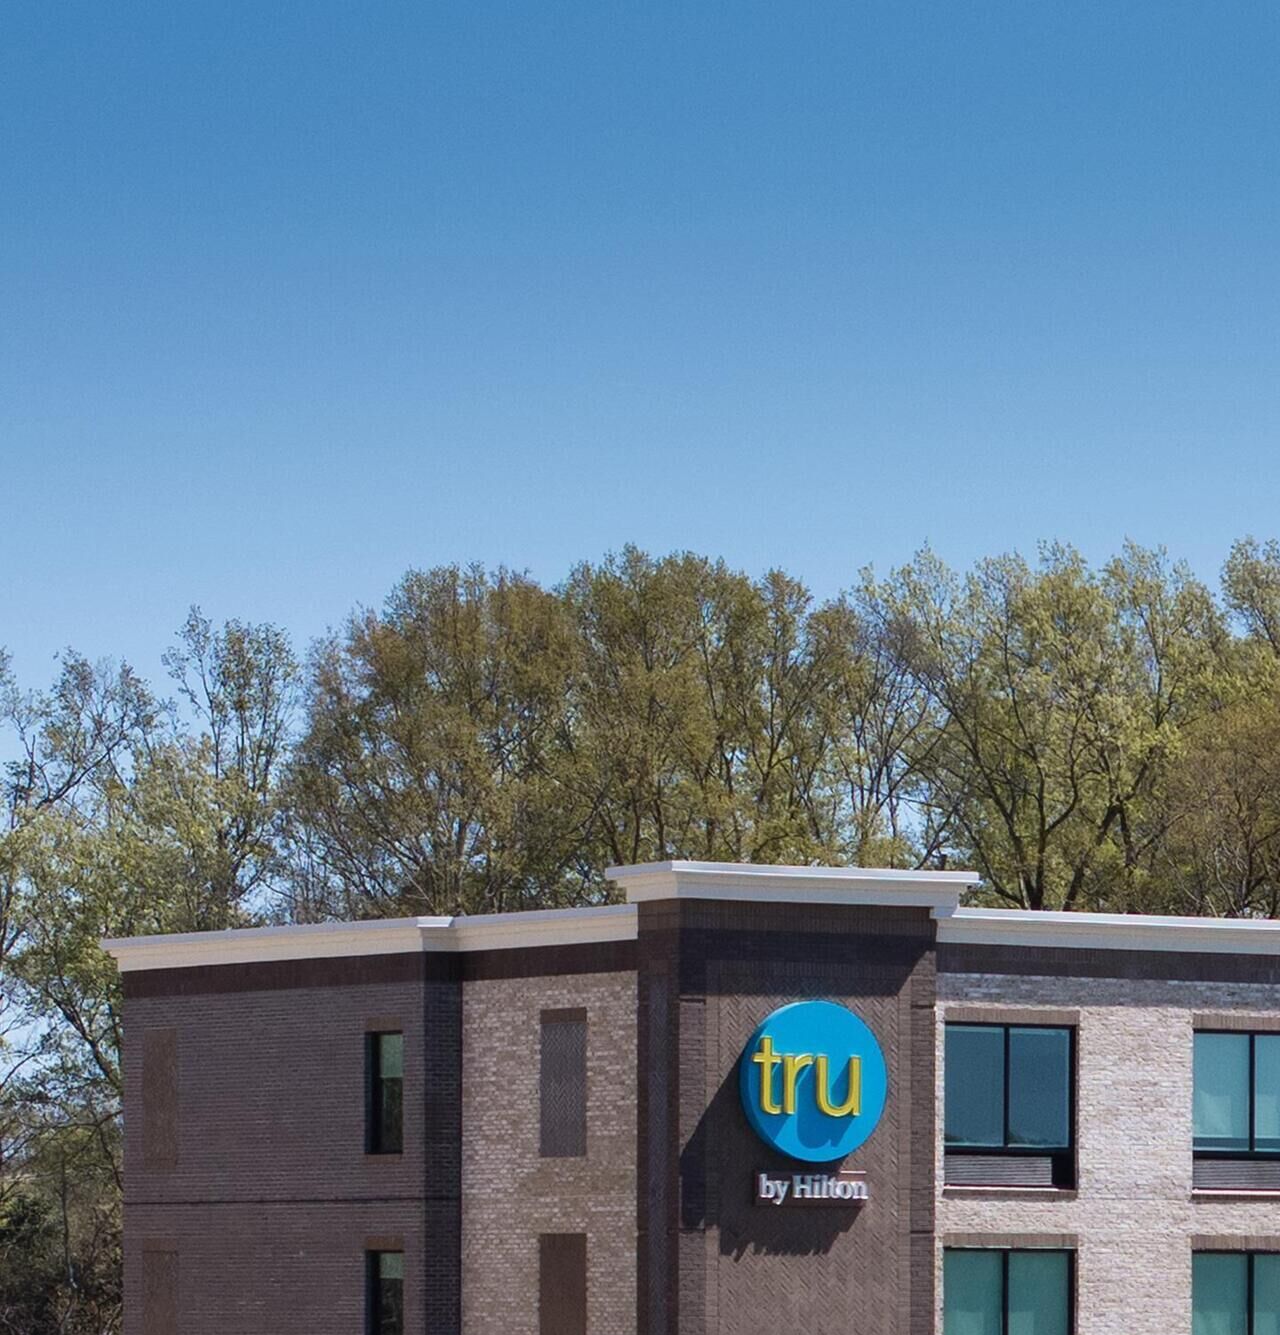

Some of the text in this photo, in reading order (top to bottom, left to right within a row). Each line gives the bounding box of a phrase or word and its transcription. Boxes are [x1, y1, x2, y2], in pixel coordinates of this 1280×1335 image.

[752, 1034, 862, 1117] tru
[759, 1173, 870, 1206] by Hilton
